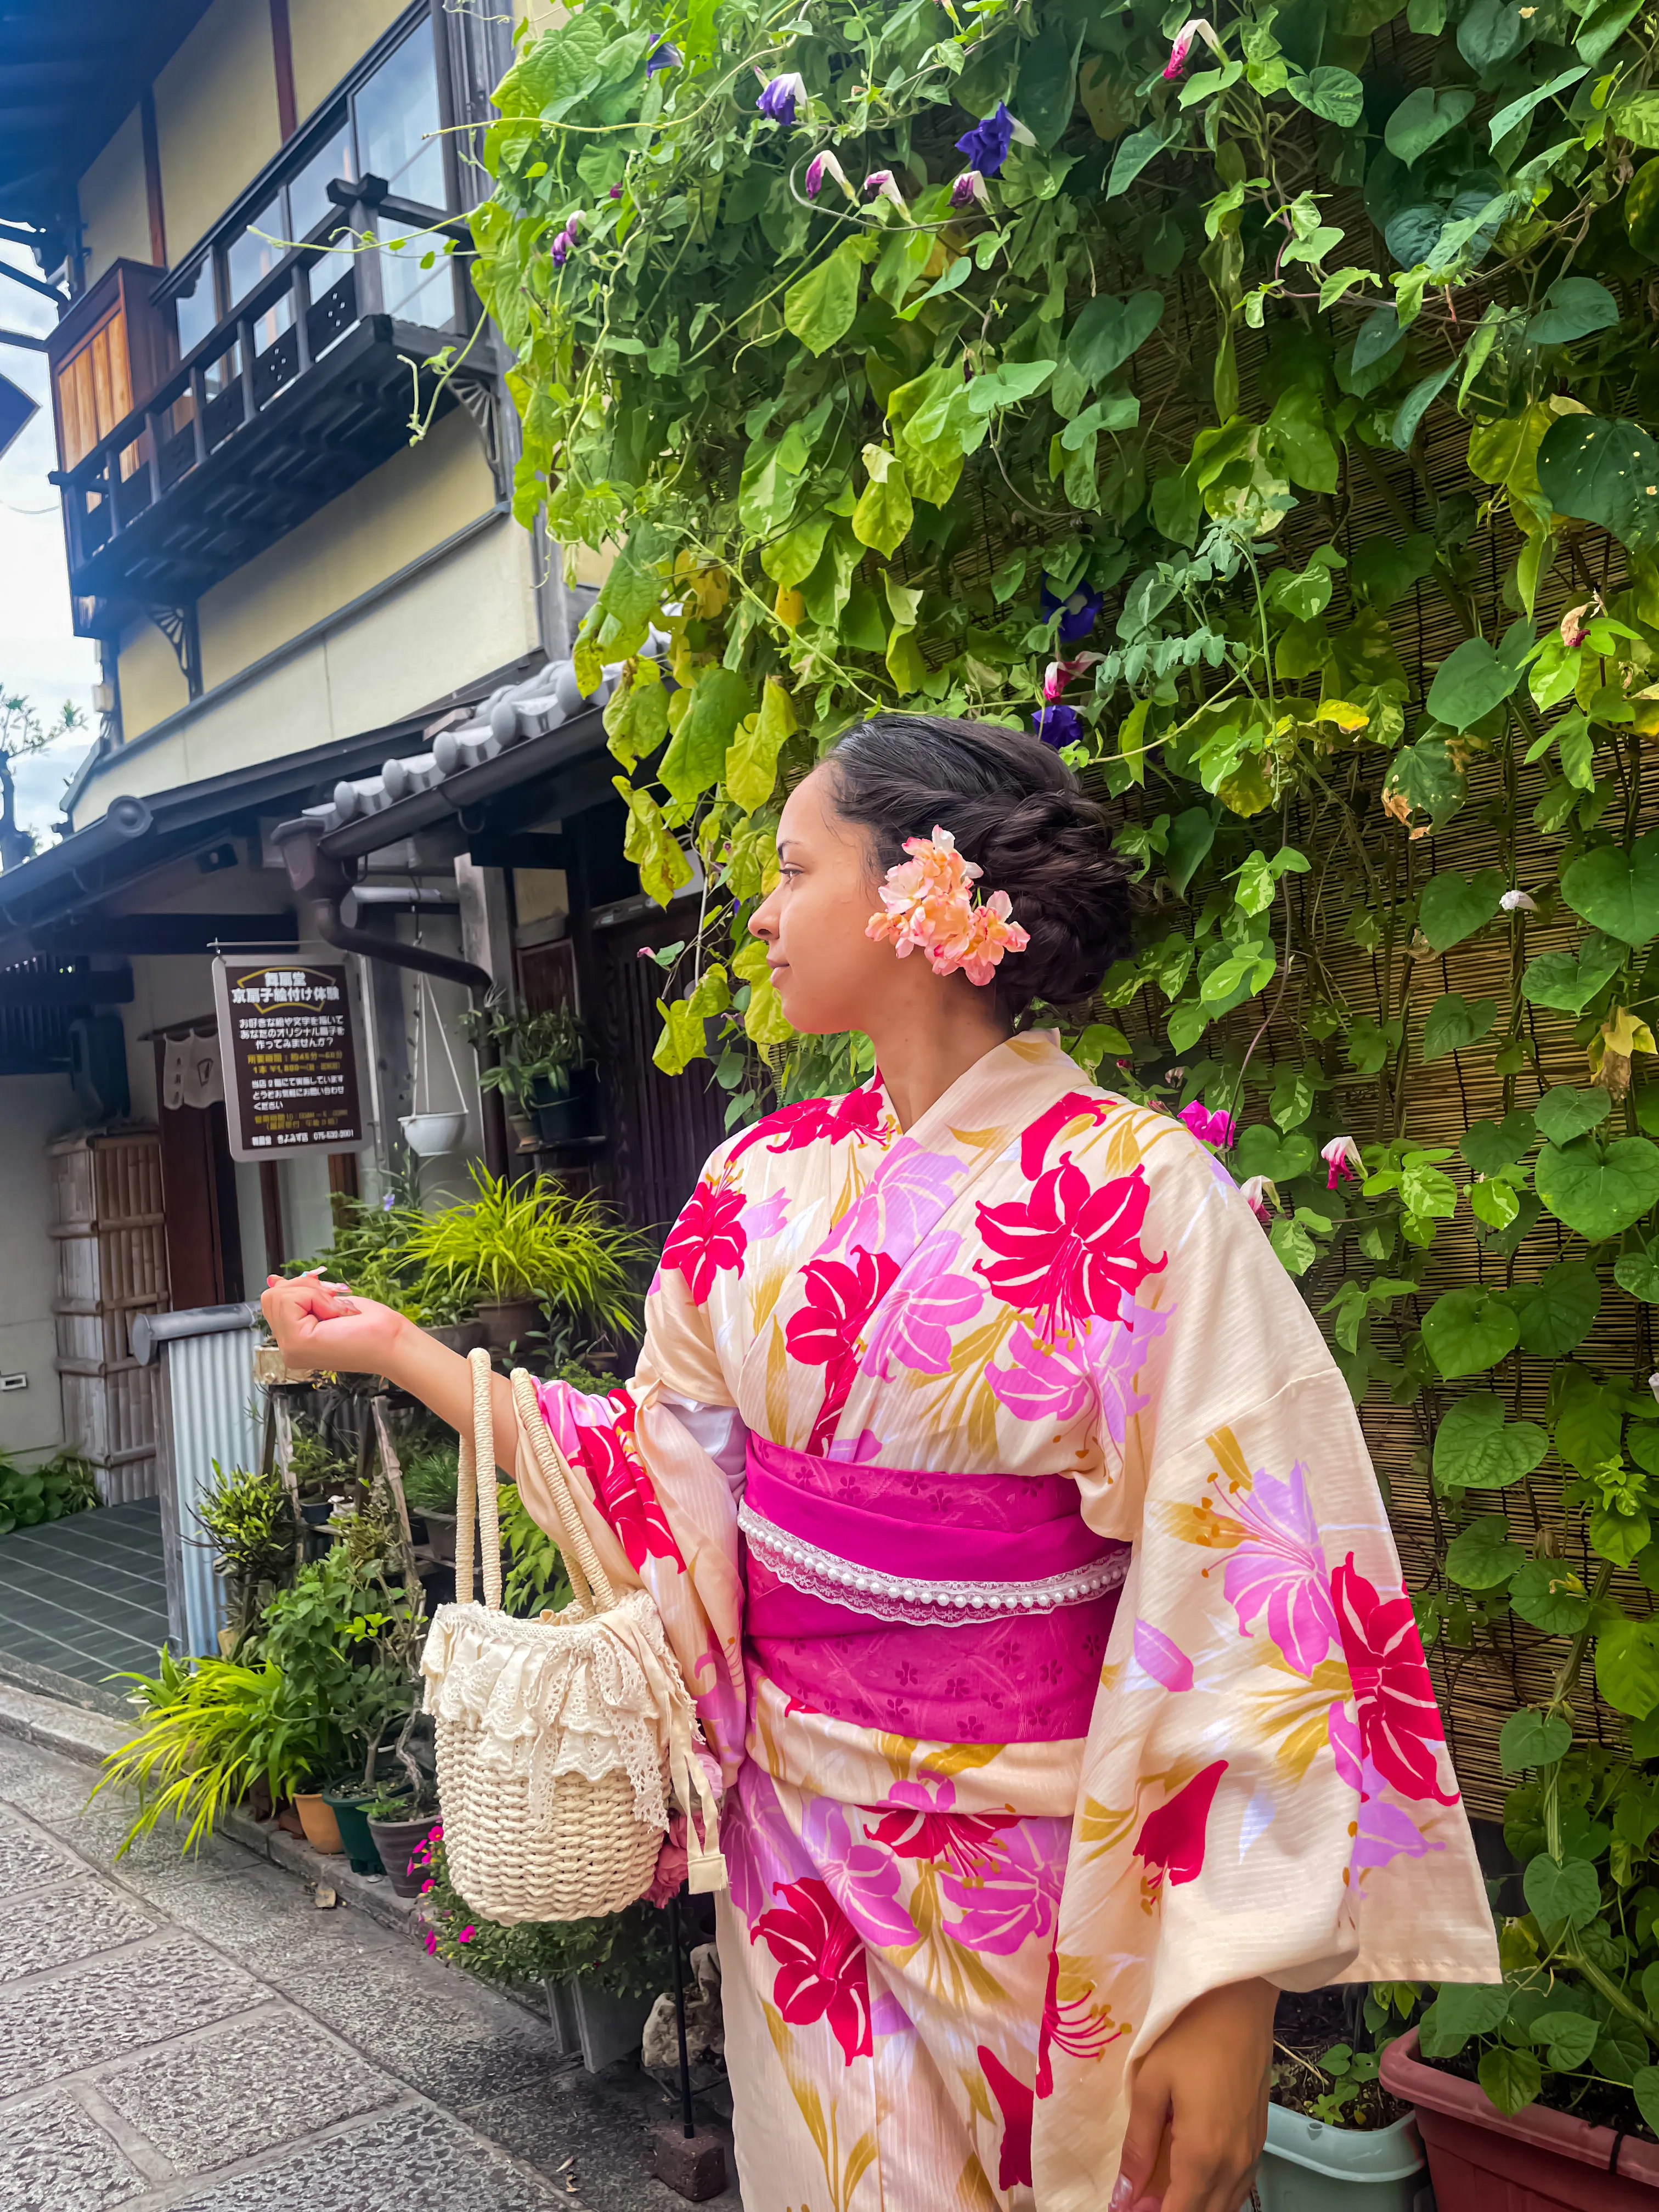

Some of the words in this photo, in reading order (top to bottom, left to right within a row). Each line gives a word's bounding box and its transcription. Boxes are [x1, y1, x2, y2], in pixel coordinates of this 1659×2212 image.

[232, 986, 340, 1003] 京扇子絵付け体験
[251, 1075, 344, 1089] 当店2にて実しています
[252, 1086, 345, 1100] どうぞお気にお問い合わせ
